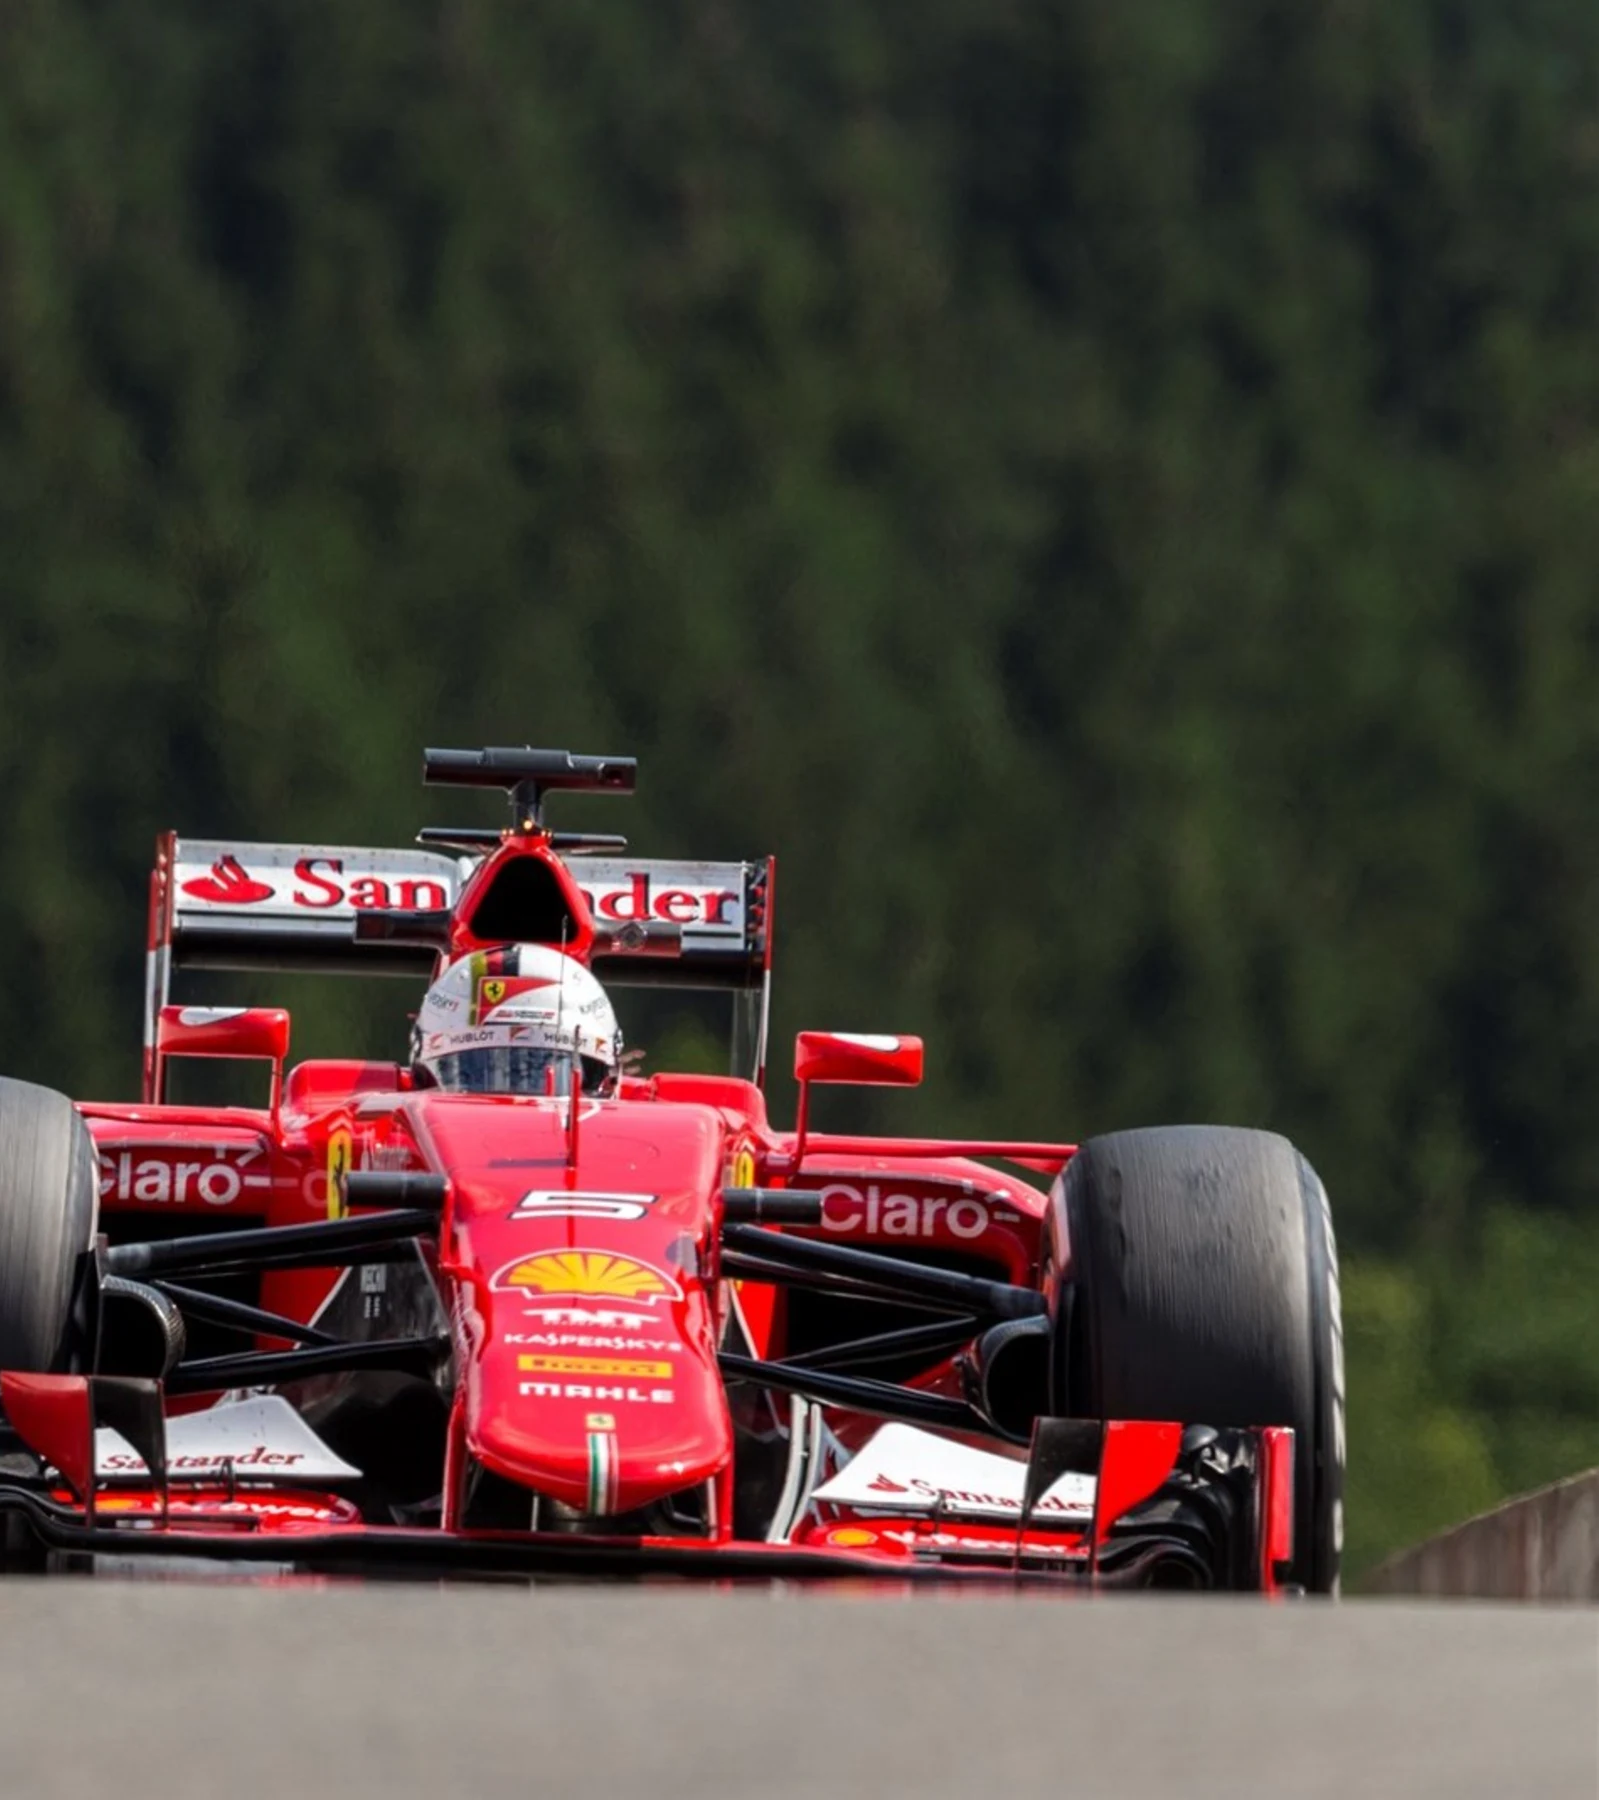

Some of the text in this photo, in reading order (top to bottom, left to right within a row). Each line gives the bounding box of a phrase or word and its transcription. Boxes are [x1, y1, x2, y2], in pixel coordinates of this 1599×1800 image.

[507, 1189, 660, 1220] 5
[820, 1184, 989, 1239] Claro
[522, 1308, 662, 1330] TNT
[519, 1382, 675, 1404] MAHLE
[101, 1446, 305, 1470] Satander
